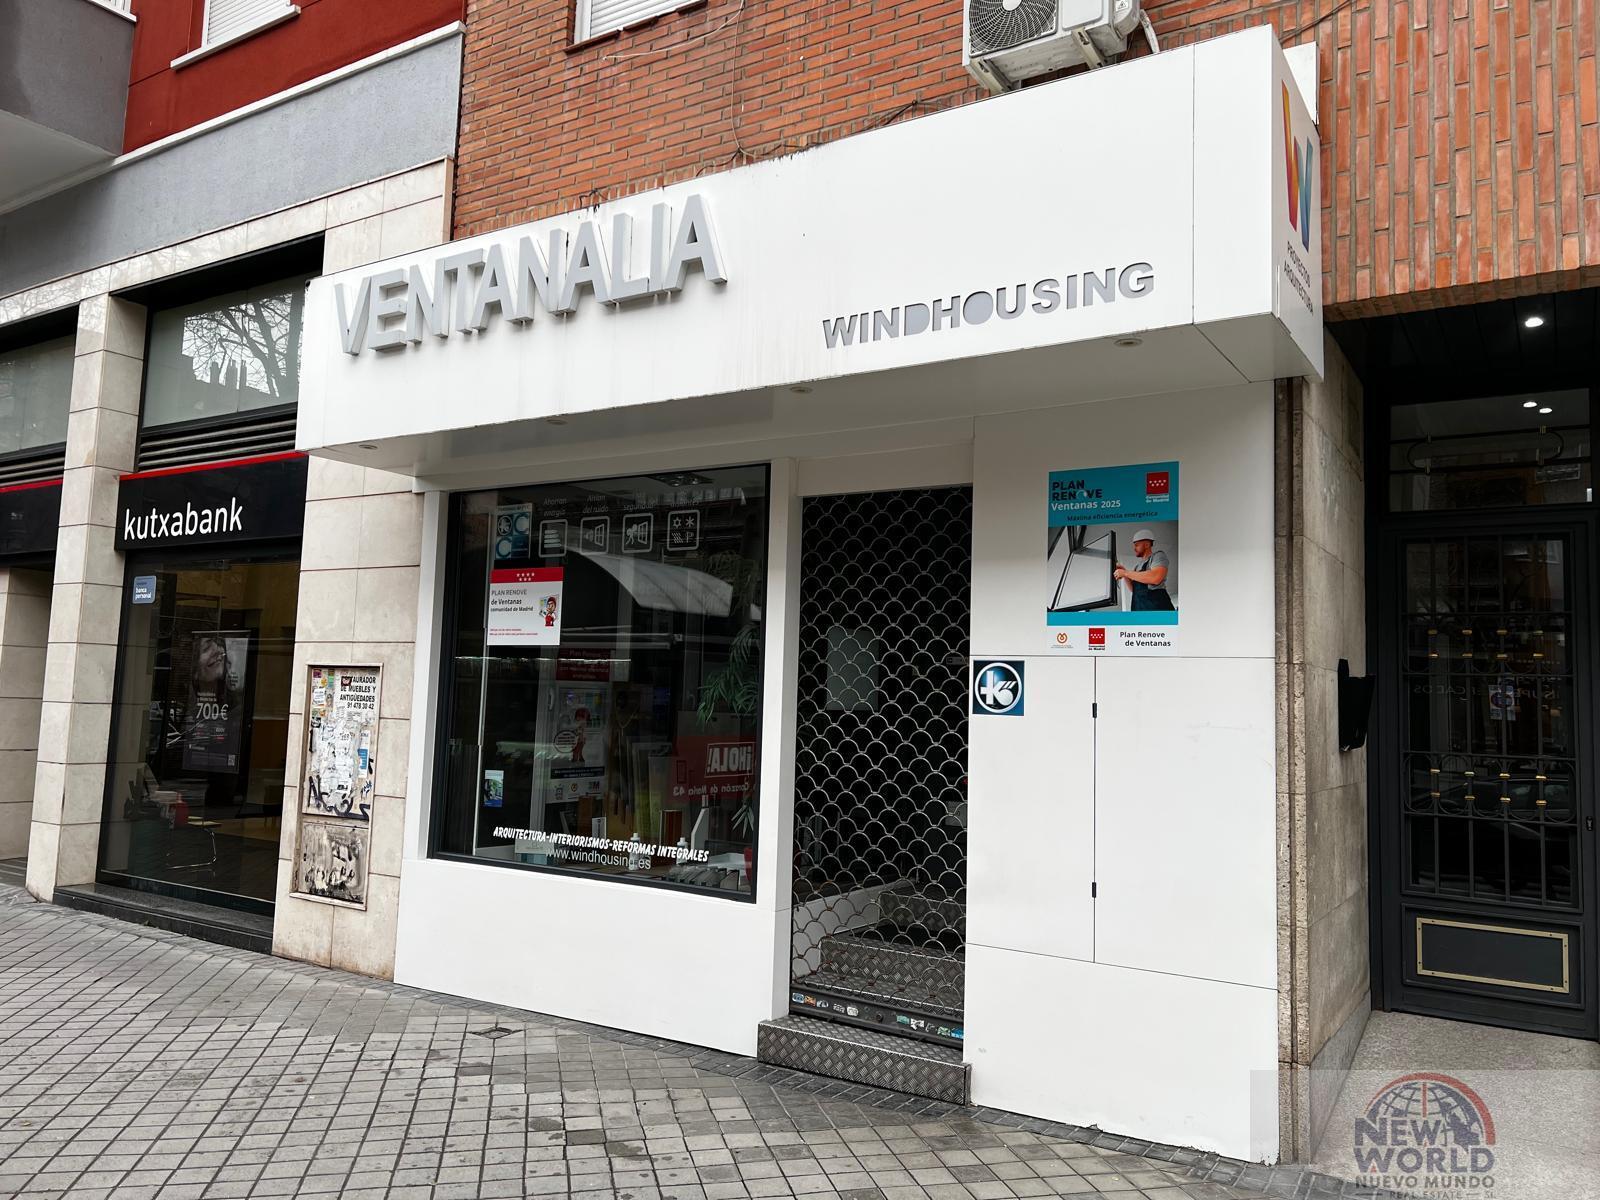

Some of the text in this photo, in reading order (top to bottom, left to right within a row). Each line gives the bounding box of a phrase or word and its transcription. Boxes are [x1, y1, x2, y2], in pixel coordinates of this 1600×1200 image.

[334, 194, 728, 356] VENTANALIA
[1287, 241, 1311, 288] PROYECTOS
[822, 262, 1154, 349] WINDHOUSING
[1284, 260, 1313, 315] ARQUITECTURA
[1051, 500, 1121, 510] Ventanas 2025
[1052, 480, 1085, 490] PLAN
[124, 496, 243, 540] kutxabank
[657, 846, 709, 862] INTEGRALES
